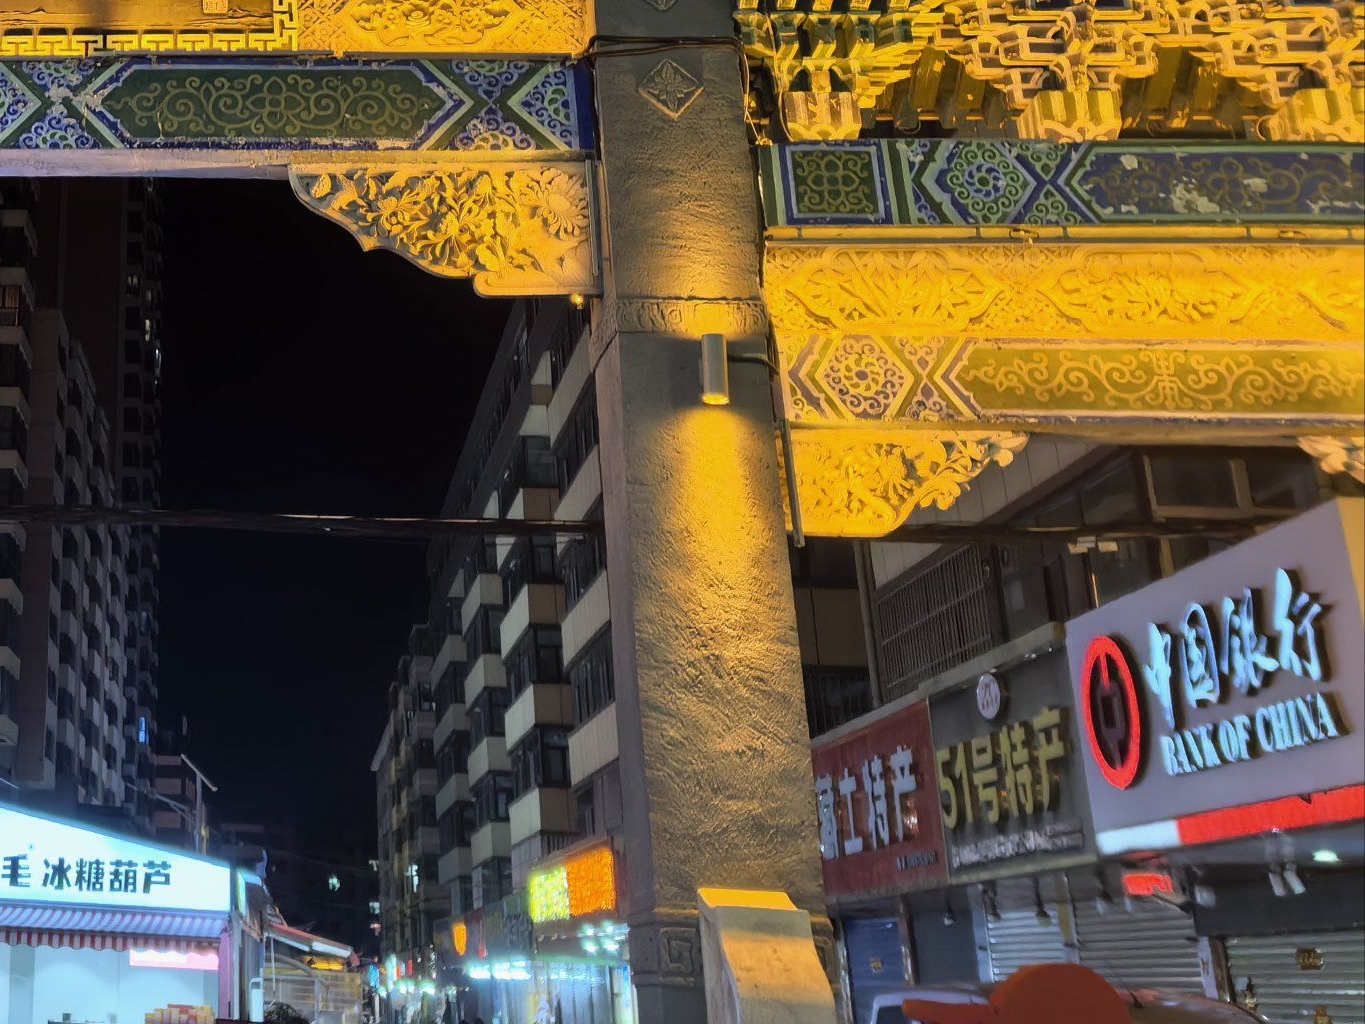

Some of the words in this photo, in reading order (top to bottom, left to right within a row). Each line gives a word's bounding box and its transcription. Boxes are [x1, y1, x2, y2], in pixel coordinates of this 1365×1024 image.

[1143, 567, 1322, 731] 中国银行
[935, 706, 1065, 829] 51号特产
[1159, 723, 1222, 776] BANK
[1218, 715, 1252, 763] OF
[1255, 691, 1339, 753] CHINA
[41, 856, 172, 894] 冰糖葫芦
